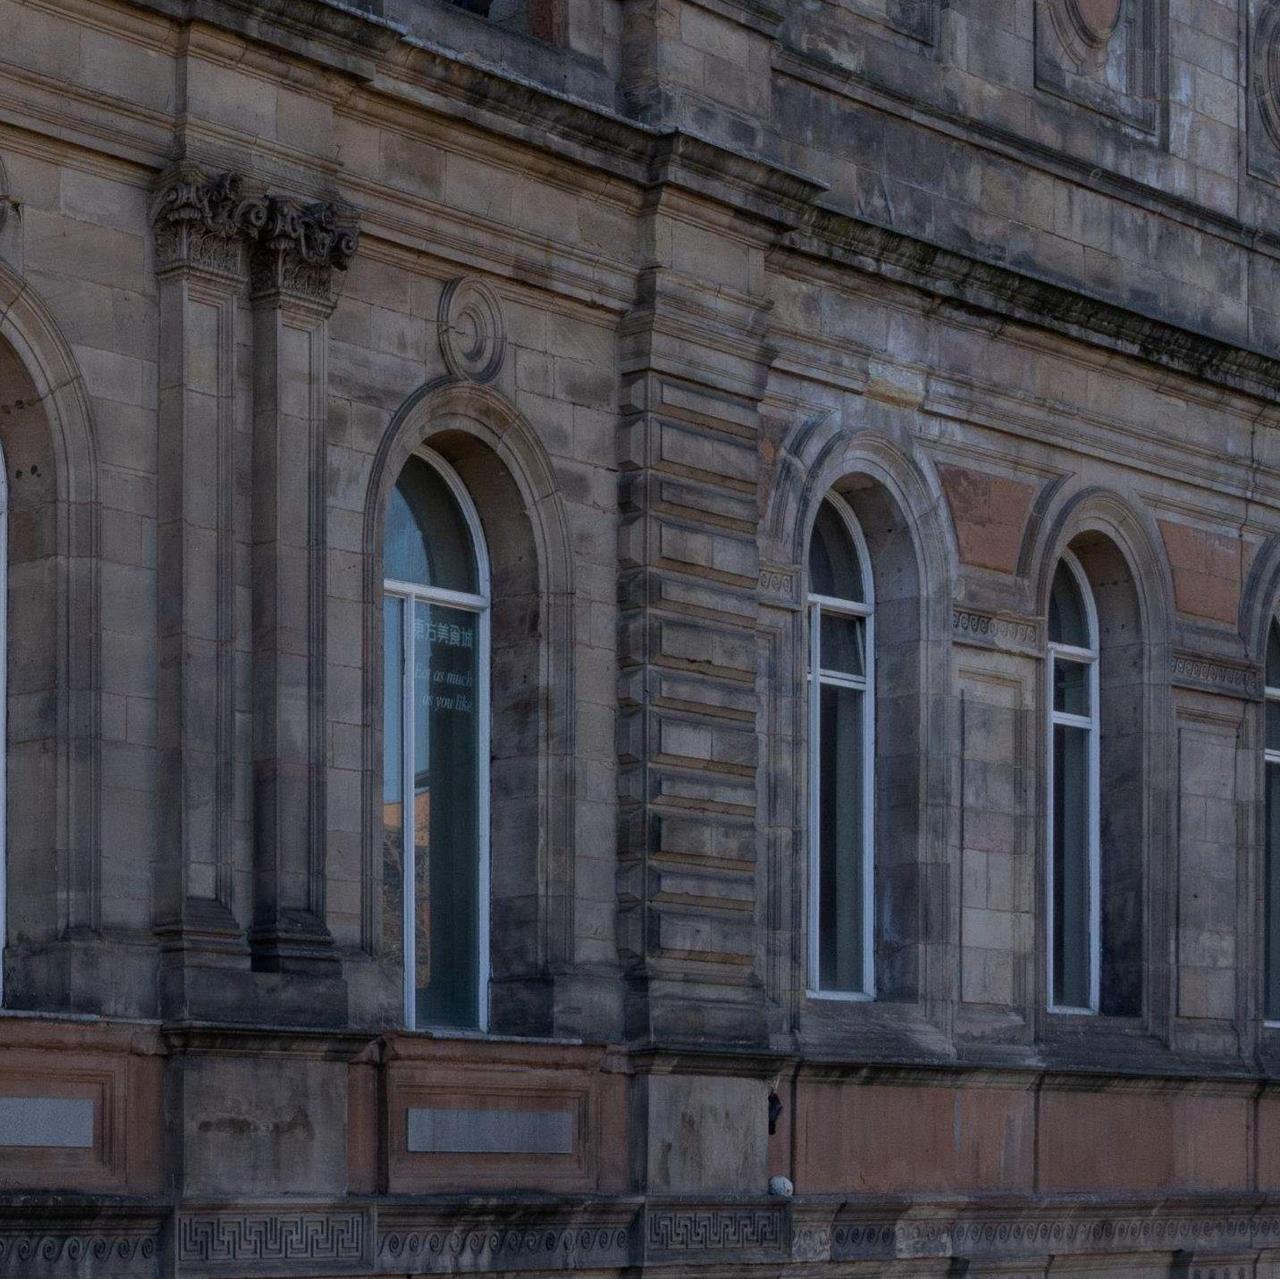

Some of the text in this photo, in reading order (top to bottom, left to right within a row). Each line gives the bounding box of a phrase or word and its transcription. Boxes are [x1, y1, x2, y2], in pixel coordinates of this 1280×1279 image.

[446, 671, 472, 687] much
[436, 696, 455, 712] you
[455, 694, 472, 711] like
